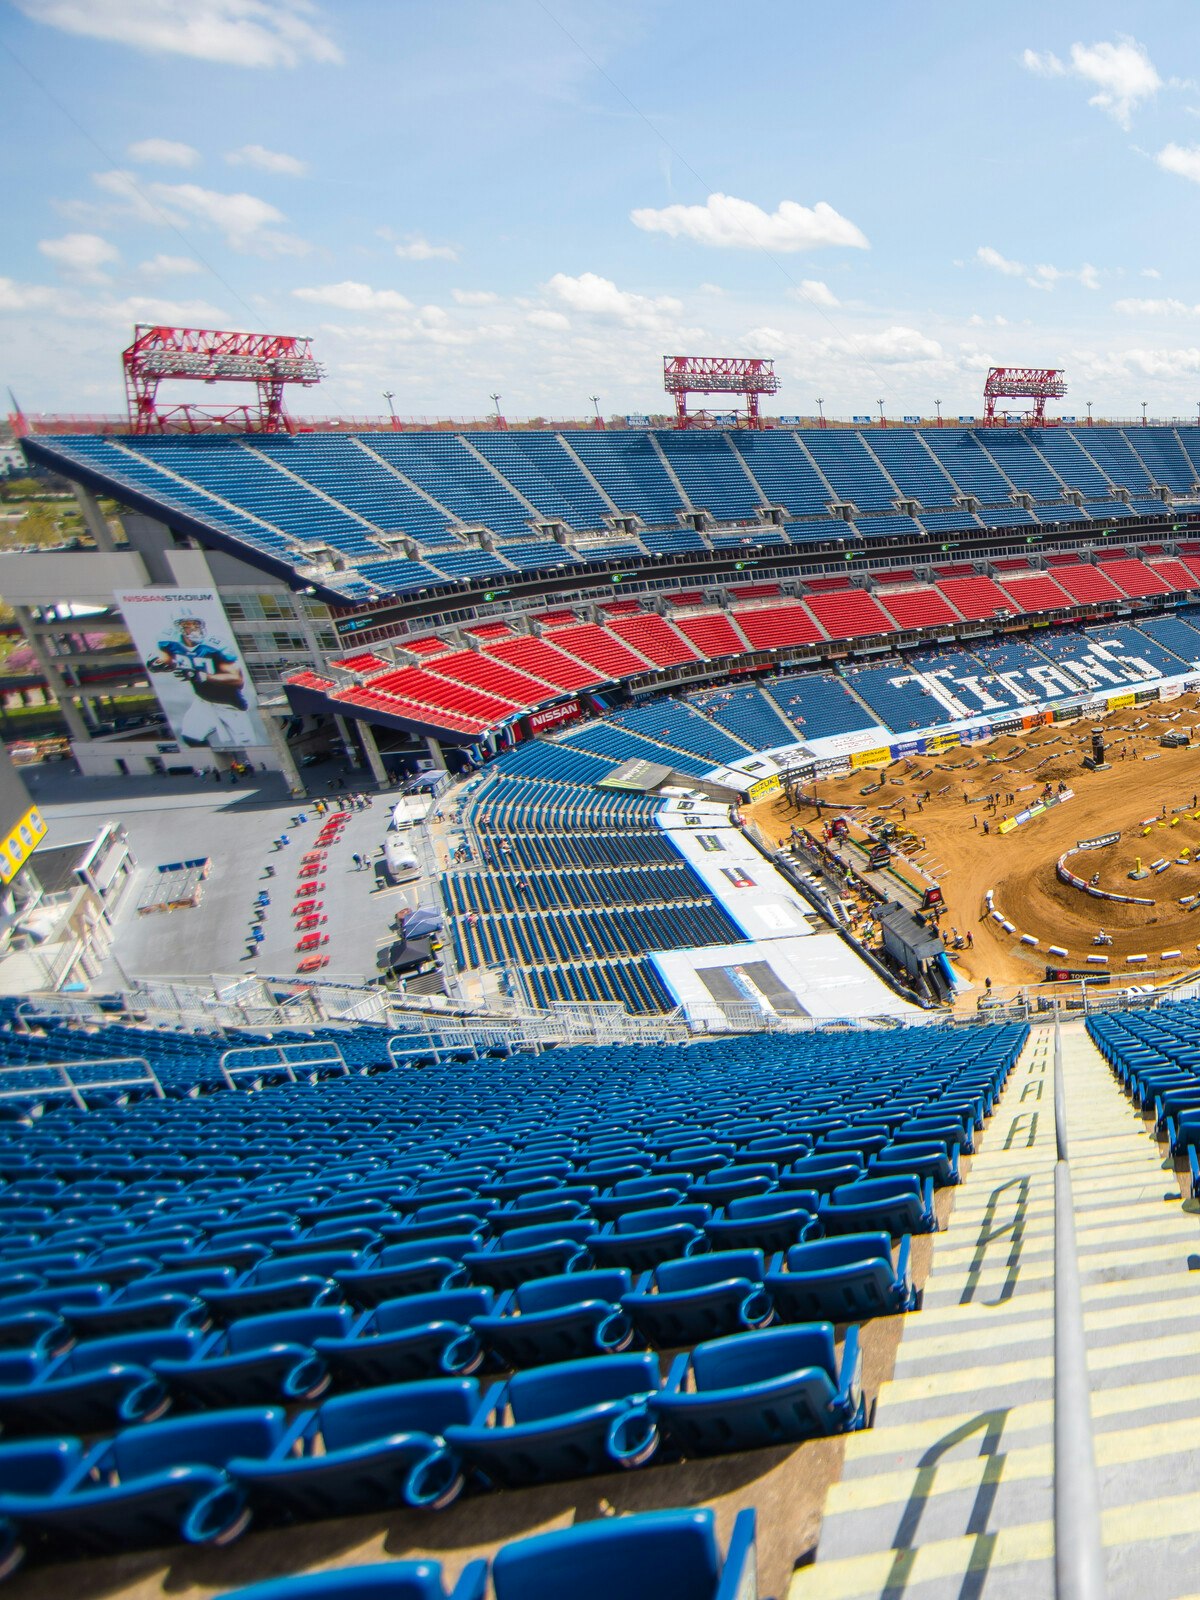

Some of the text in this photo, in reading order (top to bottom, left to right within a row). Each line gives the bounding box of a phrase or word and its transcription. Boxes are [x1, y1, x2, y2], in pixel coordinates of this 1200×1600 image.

[888, 640, 1163, 720] TITANS
[533, 703, 578, 727] NISSAN
[750, 776, 779, 794] SUZUKI
[752, 787, 780, 802] SUZUKI
[1090, 834, 1120, 847] OAKLEY
